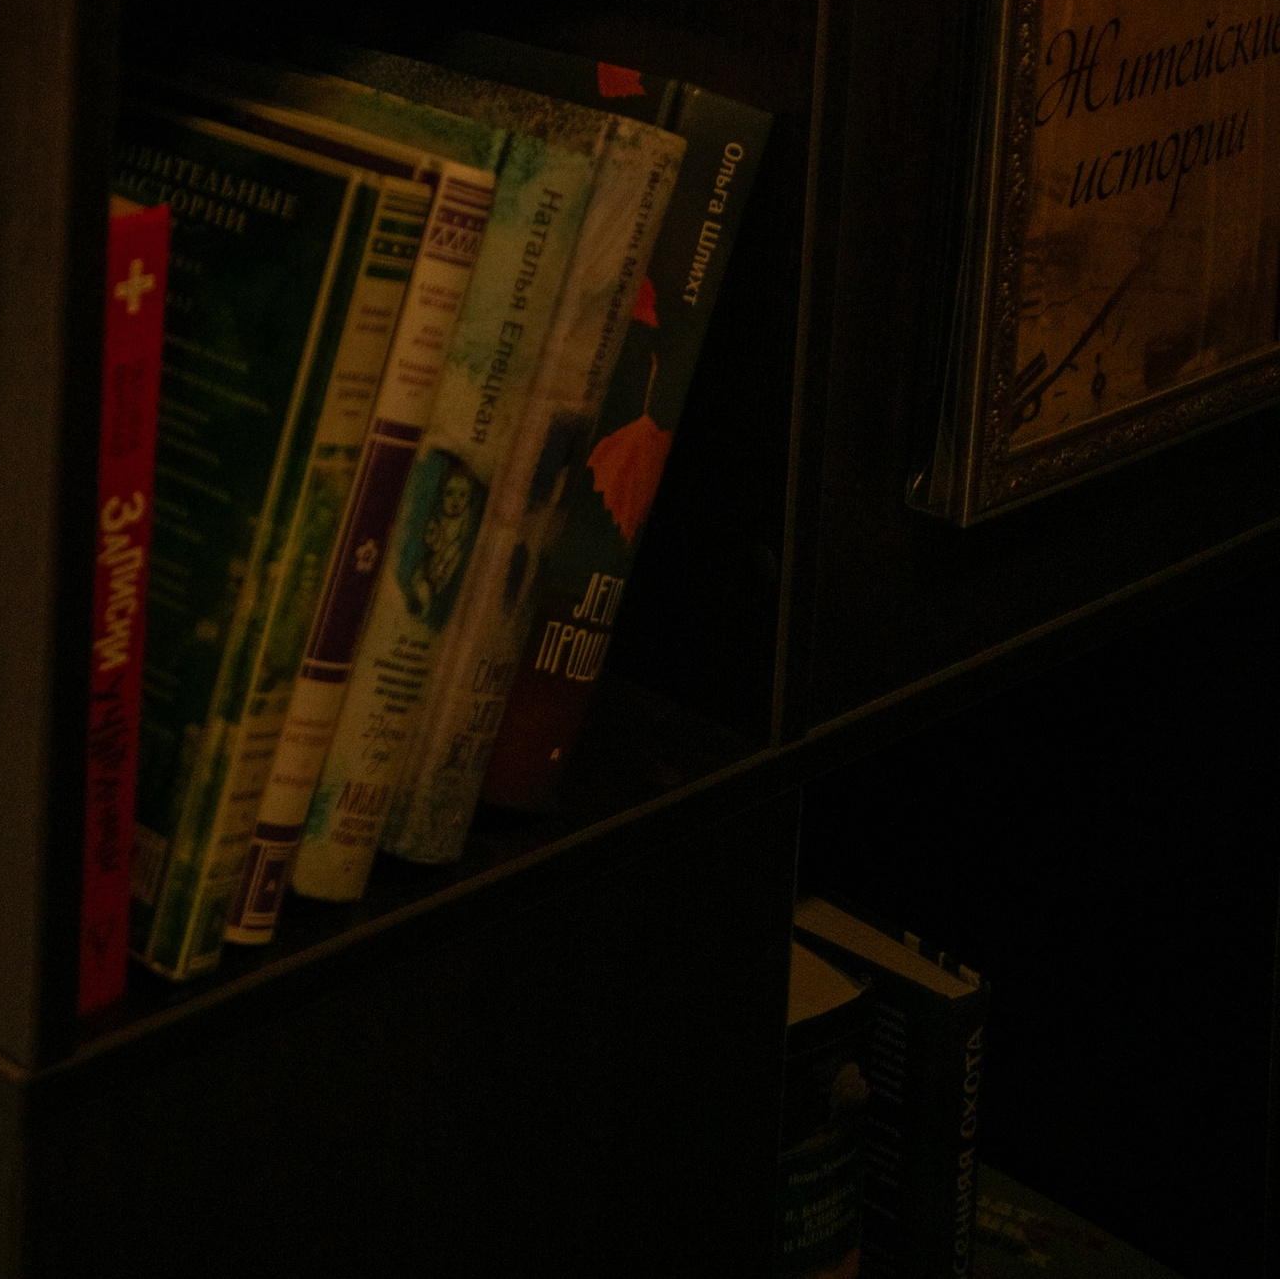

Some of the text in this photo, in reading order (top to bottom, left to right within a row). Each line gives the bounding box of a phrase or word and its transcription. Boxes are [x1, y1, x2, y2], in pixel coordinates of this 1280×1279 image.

[682, 140, 745, 306] Ольга Шлихт
[1069, 107, 1249, 216] истории
[471, 188, 563, 444] Наталья Елецкая
[958, 1024, 985, 1140] ОХОТА
